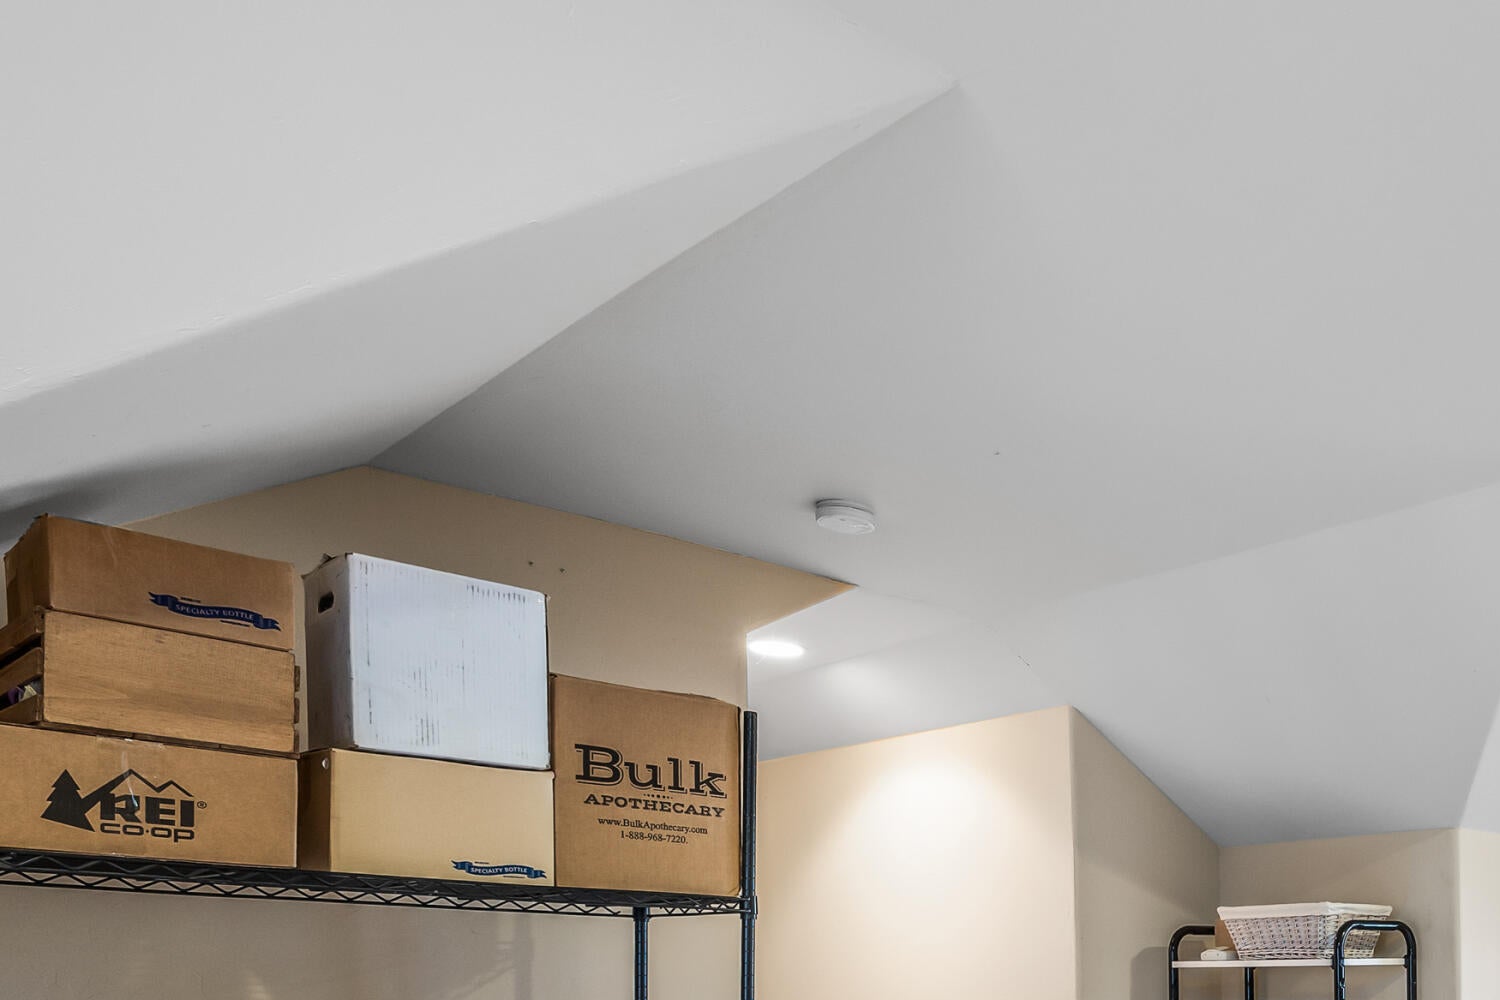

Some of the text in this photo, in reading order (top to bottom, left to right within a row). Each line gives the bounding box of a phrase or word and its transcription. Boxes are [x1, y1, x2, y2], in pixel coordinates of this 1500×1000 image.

[175, 604, 254, 620] SPECIALTY BOTTLE
[574, 743, 728, 799] Bulk
[100, 793, 195, 827] REI
[584, 793, 725, 817] APOTHECARY
[597, 817, 708, 835] www.BulkApothecary.com
